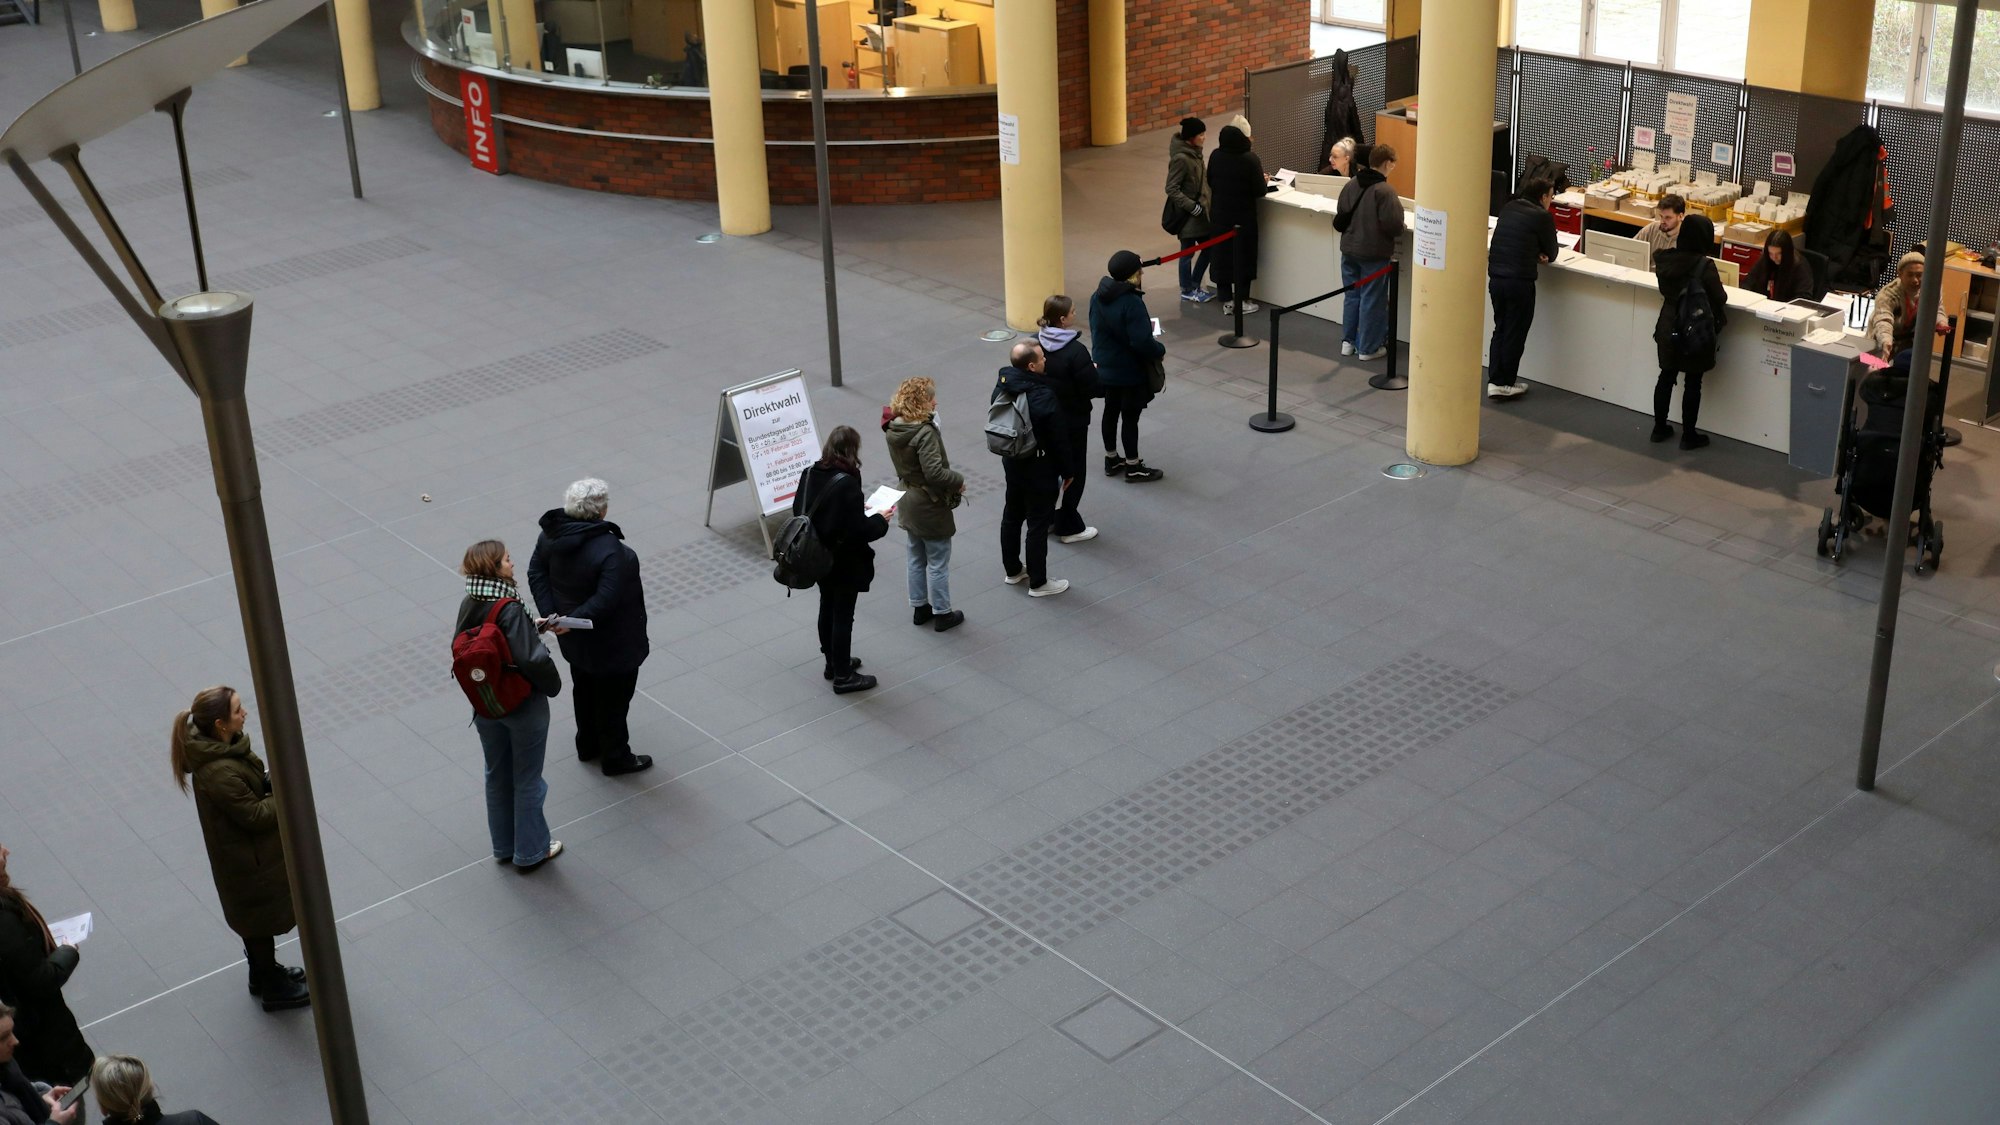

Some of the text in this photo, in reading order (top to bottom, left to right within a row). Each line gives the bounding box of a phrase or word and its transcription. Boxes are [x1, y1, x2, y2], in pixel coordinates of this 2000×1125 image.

[468, 81, 490, 163] INFO
[1763, 325, 1795, 337] Direktwahl
[743, 392, 801, 420] Direktwahl
[748, 419, 809, 444] Bundestagswahl 2025
[774, 455, 794, 466] Februar
[795, 450, 807, 459] 2025
[773, 483, 785, 492] Hier
